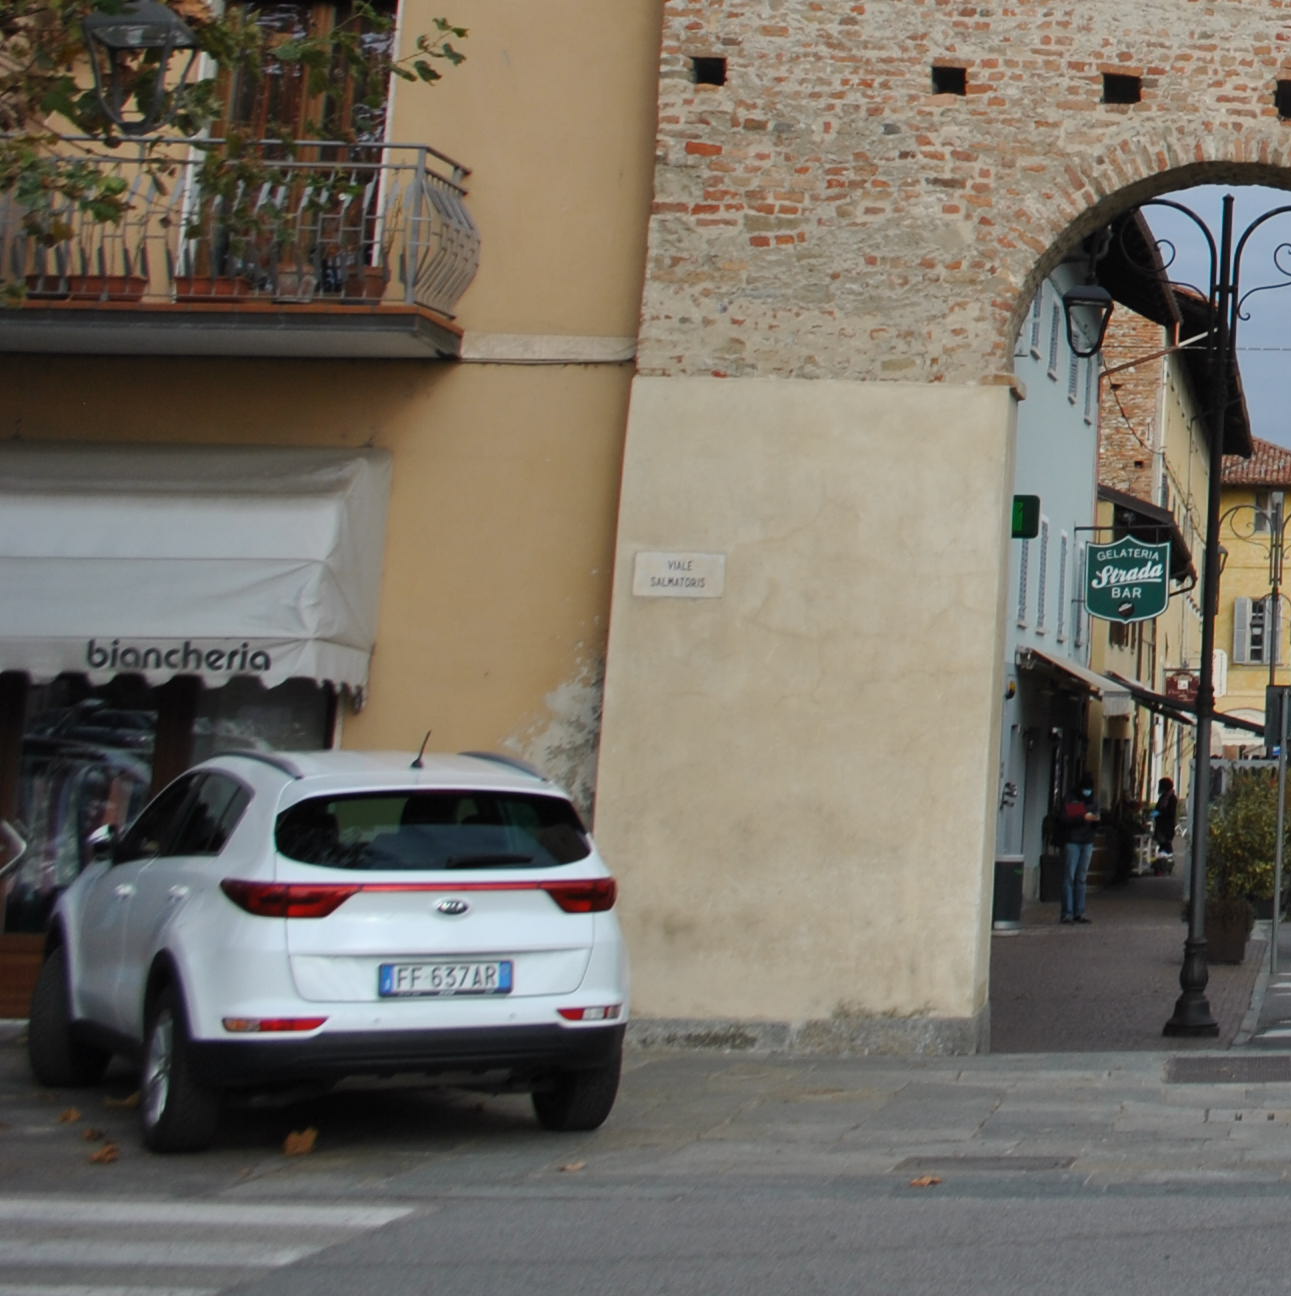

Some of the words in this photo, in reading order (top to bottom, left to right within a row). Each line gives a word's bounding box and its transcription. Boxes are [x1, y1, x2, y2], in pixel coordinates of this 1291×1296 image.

[1097, 548, 1159, 561] GELATERIA
[667, 560, 693, 571] VIALE
[1091, 560, 1163, 588] Strada
[1111, 587, 1142, 598] BAR
[87, 639, 271, 671] biancheria
[398, 966, 422, 989] FF
[431, 965, 497, 988] 637AR
